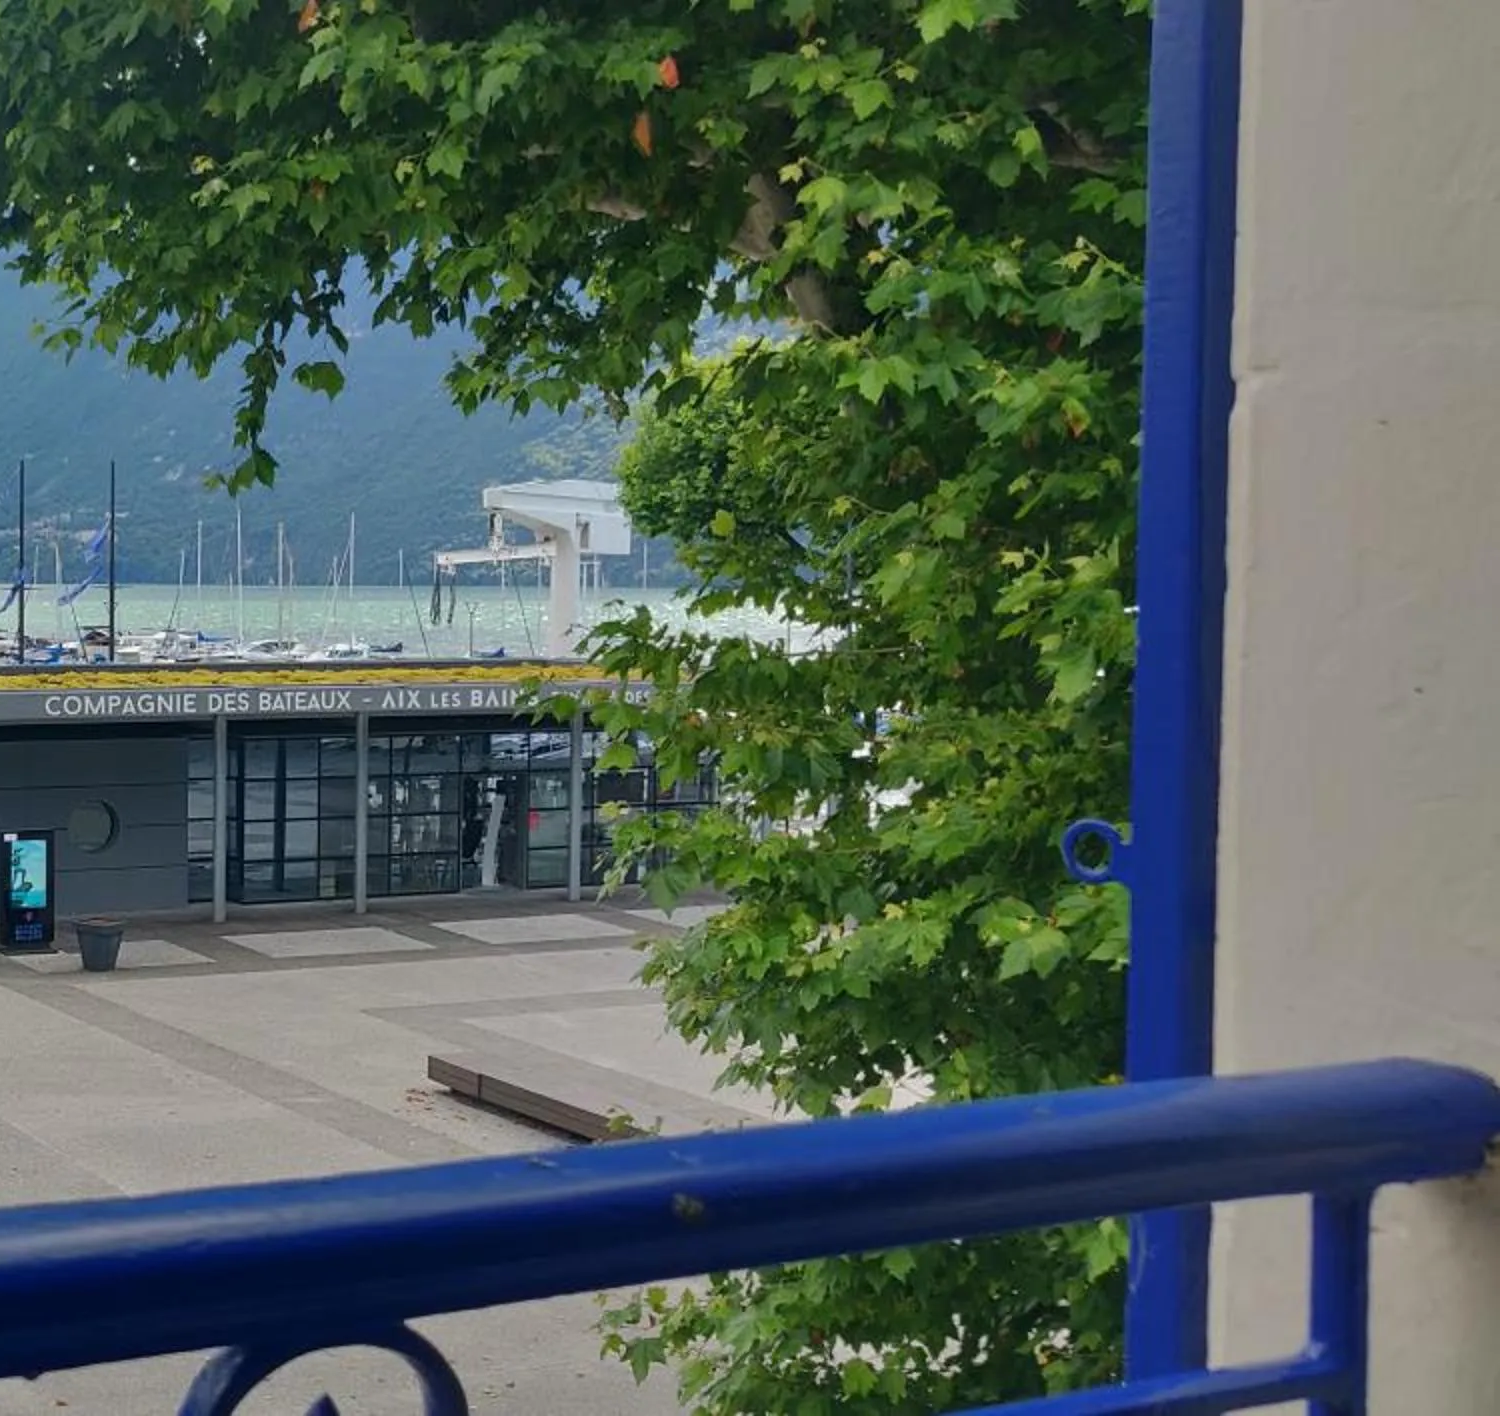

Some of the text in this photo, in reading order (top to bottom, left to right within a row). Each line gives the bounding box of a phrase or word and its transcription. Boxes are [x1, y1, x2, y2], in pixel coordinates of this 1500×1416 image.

[45, 693, 197, 715] COMPAGNIE
[208, 692, 250, 713] DES
[259, 691, 352, 711] BATEAUX
[381, 690, 421, 709] AIX
[431, 692, 461, 708] LES
